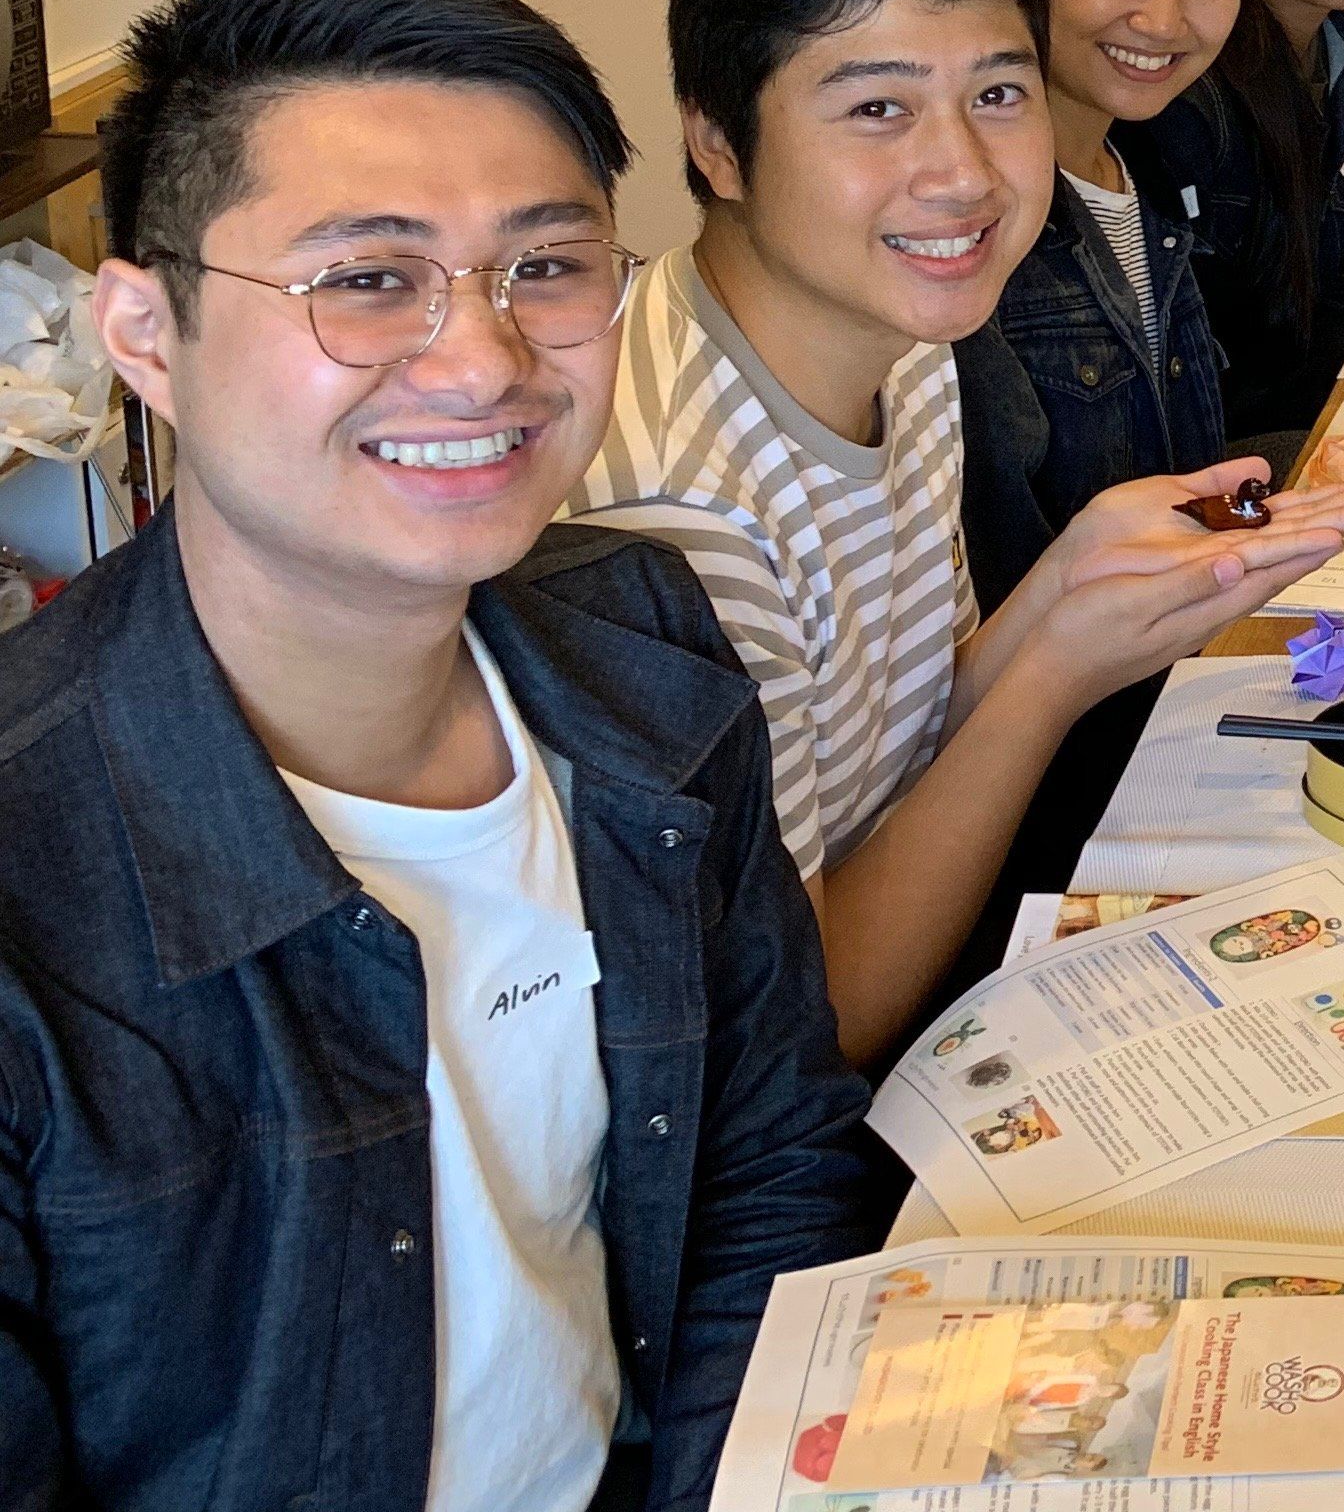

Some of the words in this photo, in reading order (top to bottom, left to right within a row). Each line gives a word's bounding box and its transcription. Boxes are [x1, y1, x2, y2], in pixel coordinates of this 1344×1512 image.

[488, 971, 560, 1021] Alvin
[1195, 1315, 1221, 1368] Cooking
[1224, 1310, 1241, 1334] The
[1193, 1368, 1212, 1401] Class
[1213, 1336, 1236, 1392] Japanese
[1260, 1362, 1284, 1410] COOK
[1277, 1355, 1302, 1414] WASHO
[1192, 1402, 1206, 1415] in
[1208, 1392, 1227, 1429] Home
[1179, 1414, 1204, 1460] English
[1199, 1430, 1221, 1462] Style
